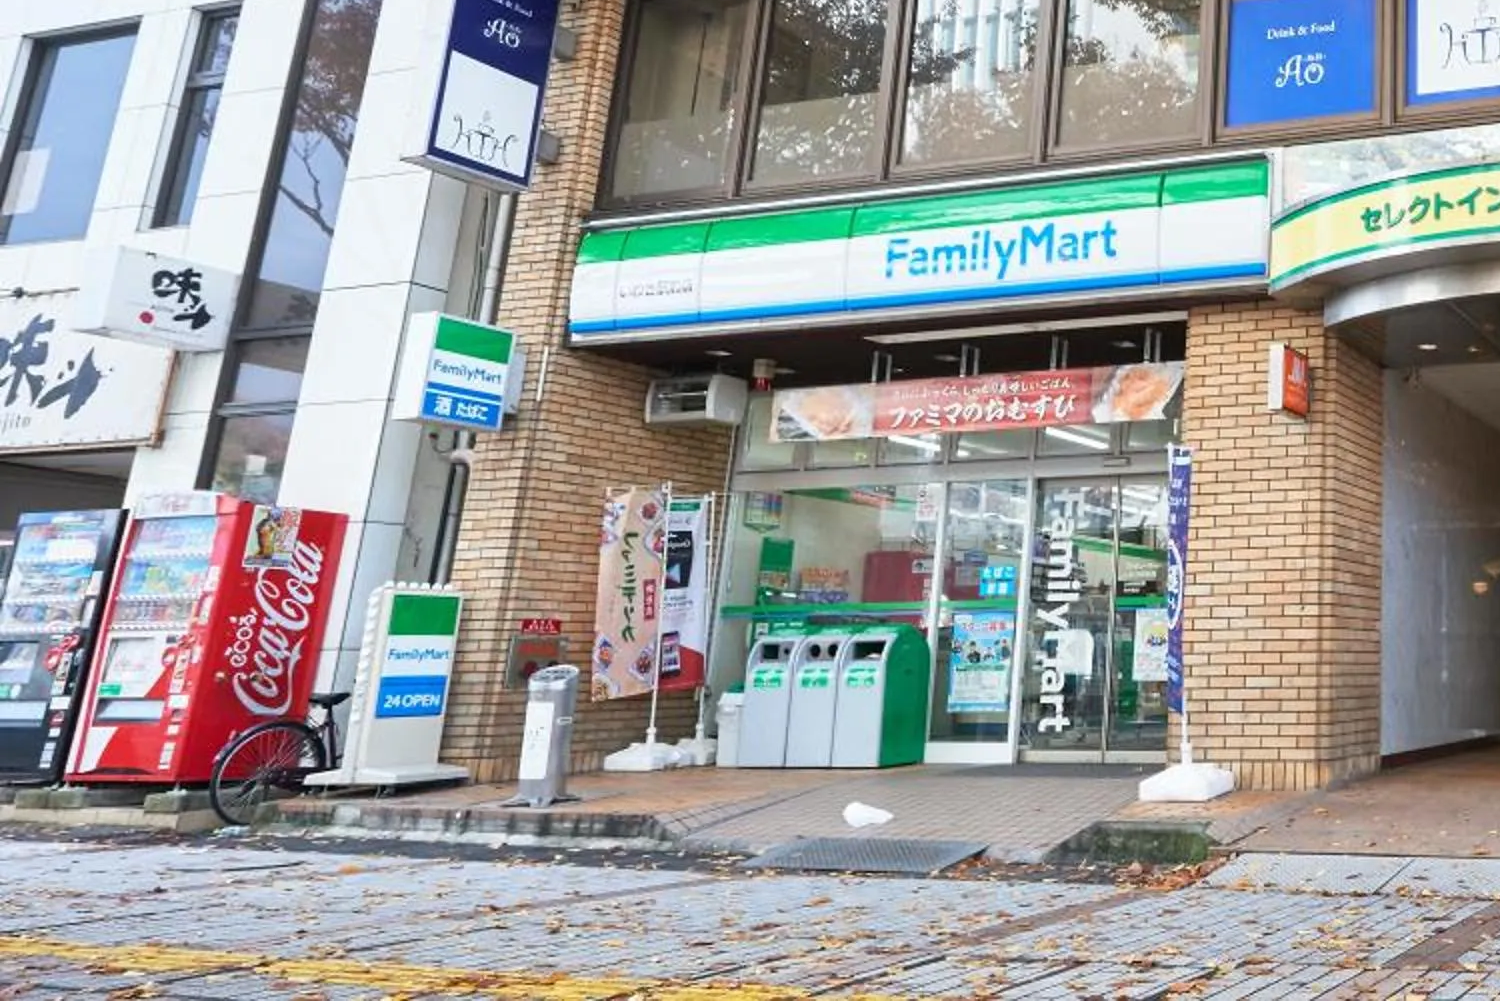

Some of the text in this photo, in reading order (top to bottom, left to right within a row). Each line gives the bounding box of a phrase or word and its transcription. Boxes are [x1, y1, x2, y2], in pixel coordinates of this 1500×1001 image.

[1267, 19, 1335, 40] Drink & Food
[885, 218, 1118, 281] FamilyMart
[433, 359, 502, 384] FamilyMart
[433, 395, 489, 421] 酒 たばこ
[890, 393, 1076, 428] ファミマのおむすび
[387, 648, 450, 664] FamilyMart
[383, 694, 441, 709] 24 OPEN
